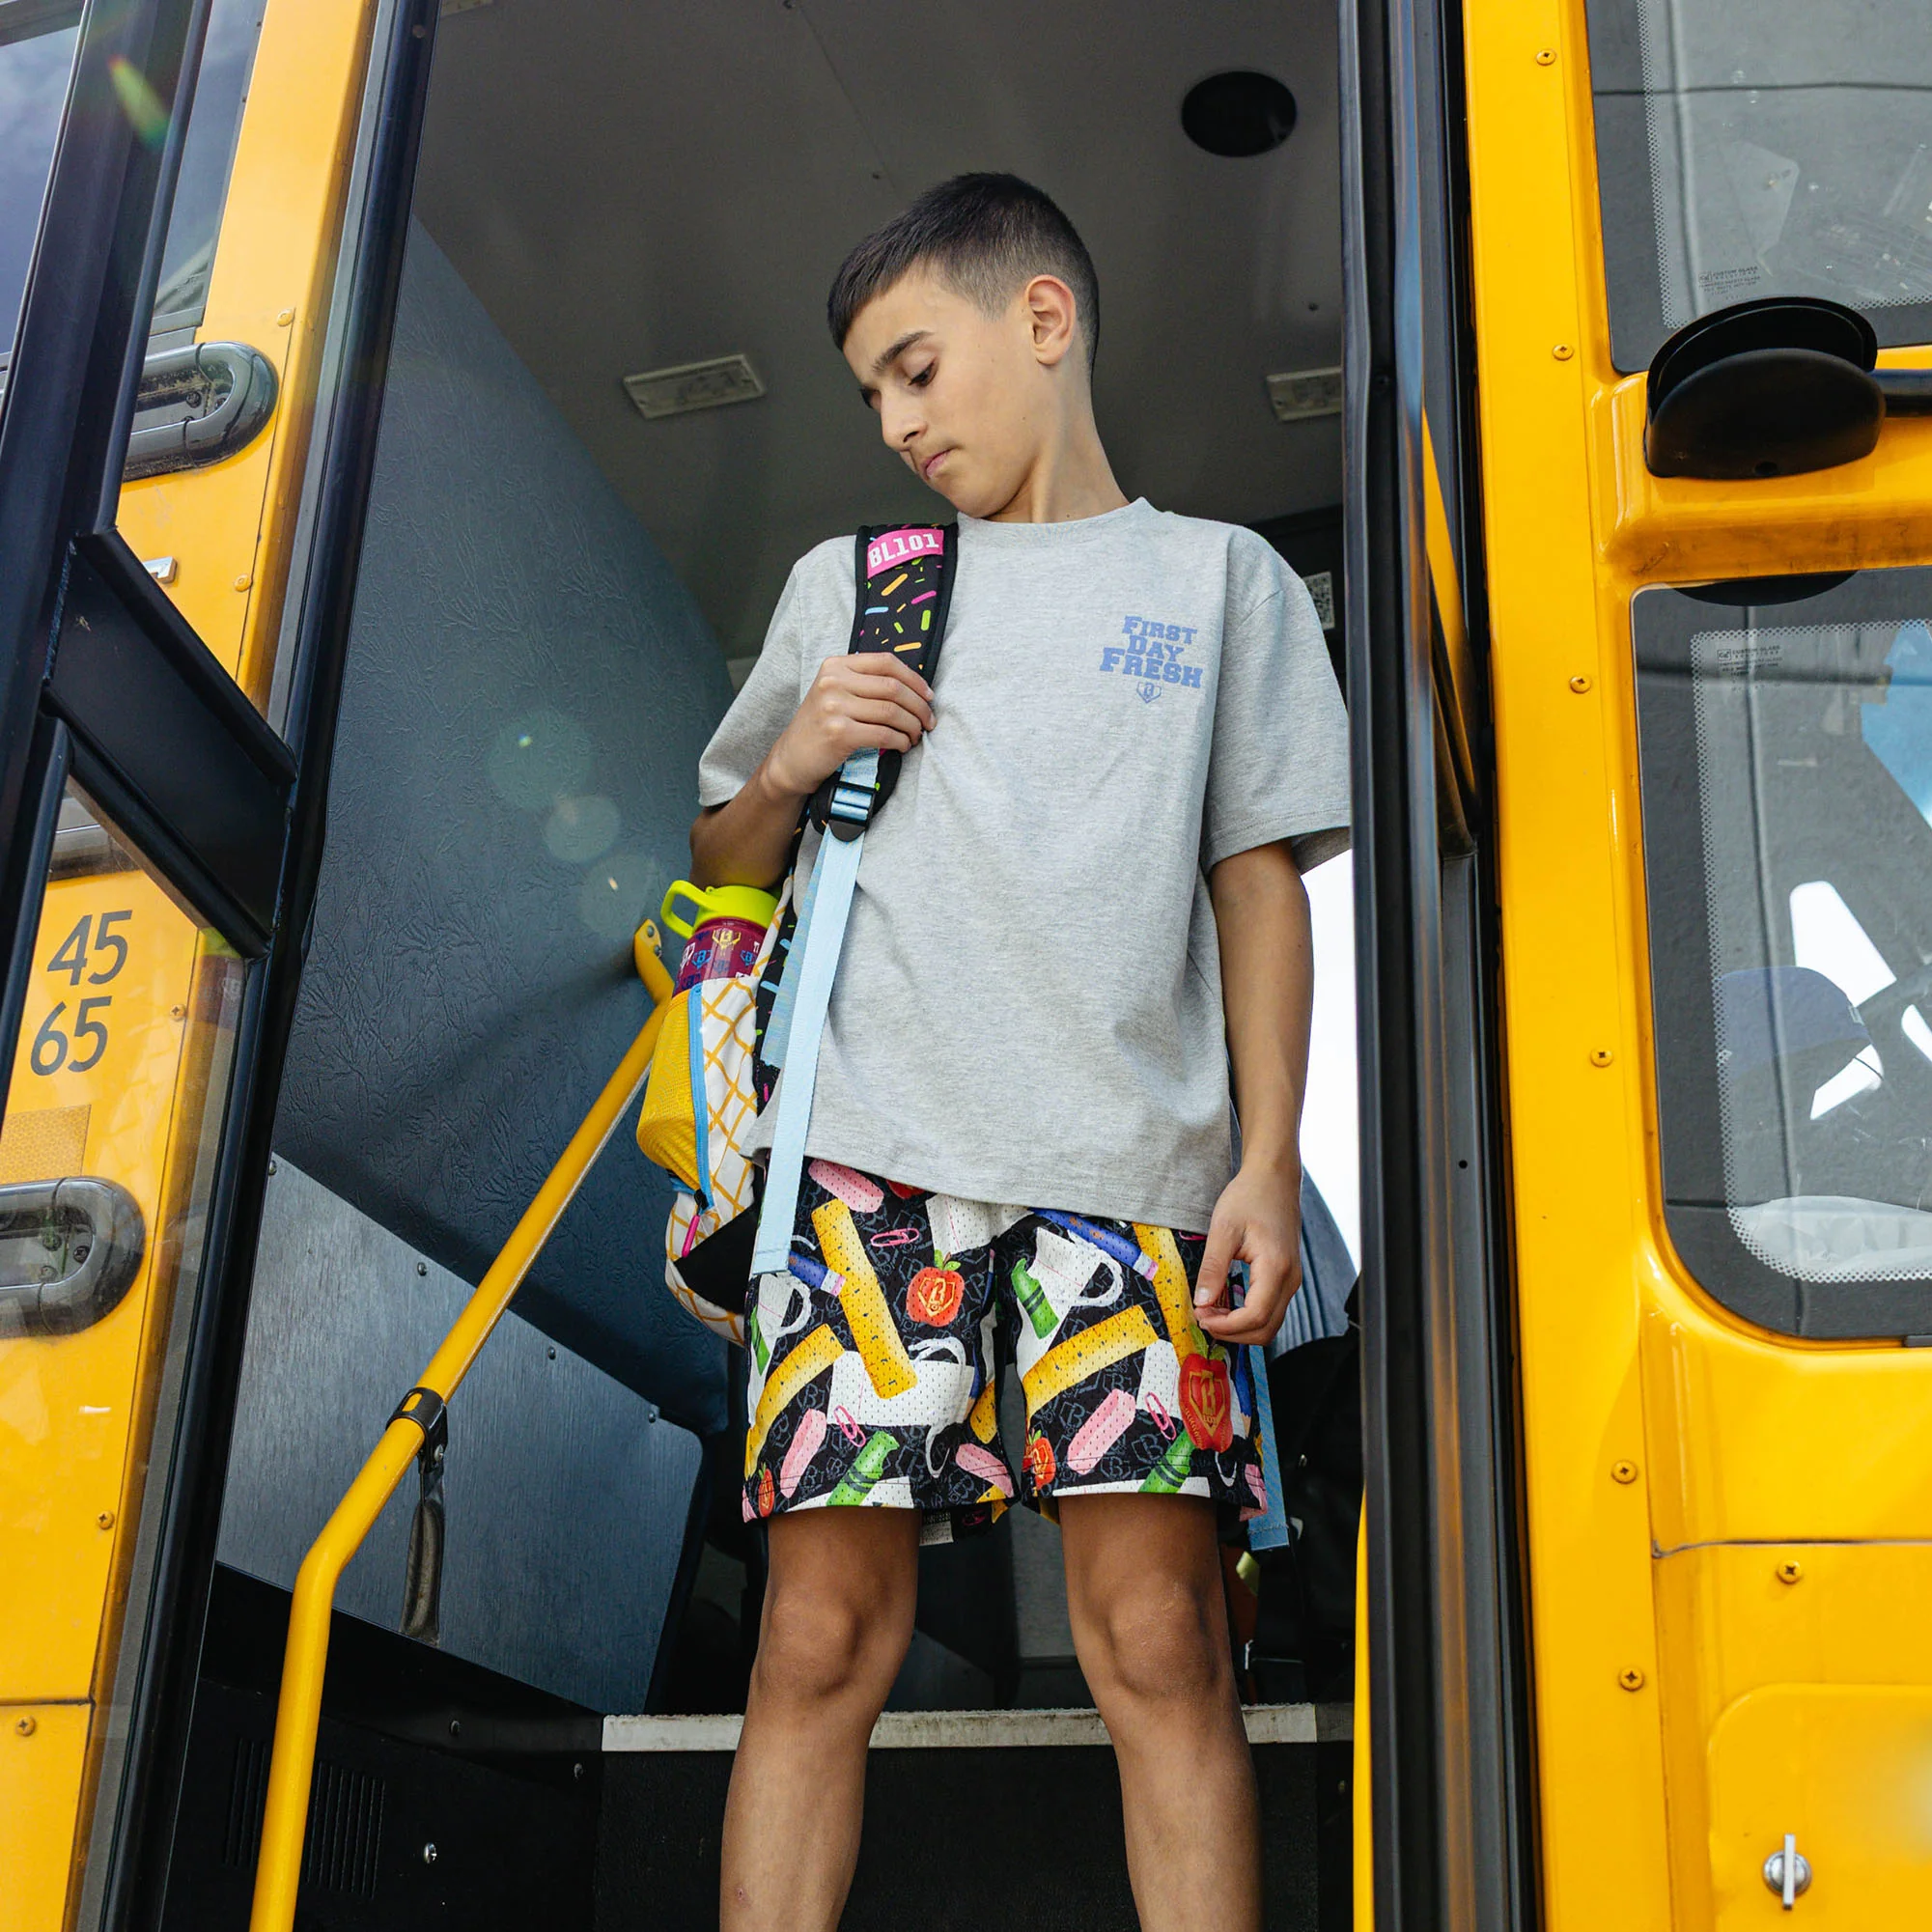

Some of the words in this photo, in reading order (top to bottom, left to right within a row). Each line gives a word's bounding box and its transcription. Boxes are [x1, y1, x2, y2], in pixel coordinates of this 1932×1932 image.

[869, 533, 939, 569] BL101
[1122, 615, 1198, 645] FIRST
[1127, 634, 1185, 662] DAY
[1099, 647, 1204, 688] FRESH
[46, 910, 133, 986] 45
[30, 995, 113, 1077] 65
